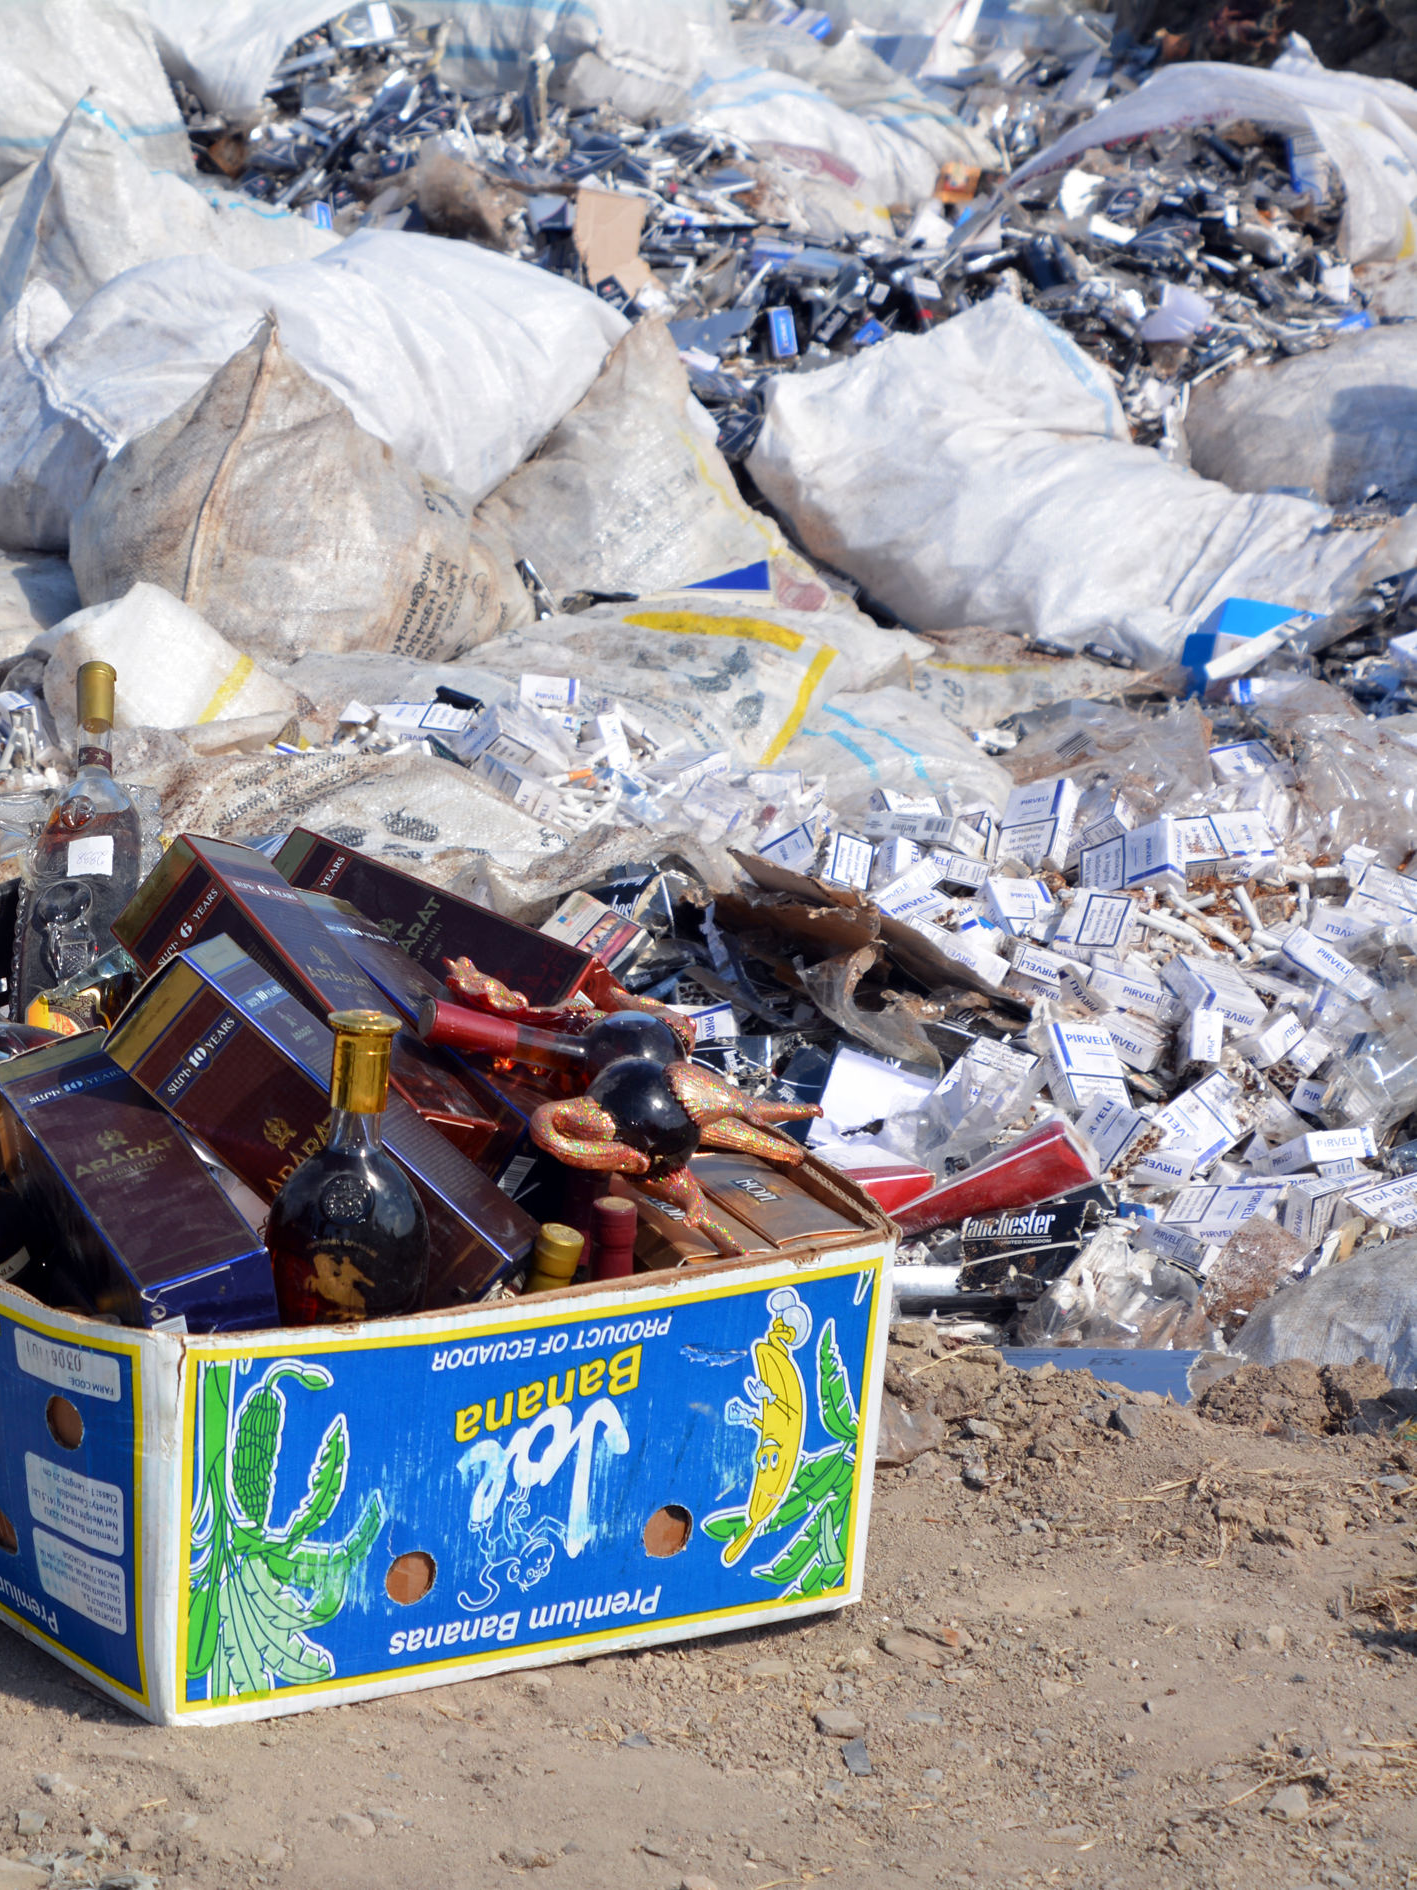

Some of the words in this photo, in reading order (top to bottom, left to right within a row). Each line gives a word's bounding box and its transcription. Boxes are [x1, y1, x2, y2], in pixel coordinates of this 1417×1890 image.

[534, 691, 563, 701] PIRVELI
[1020, 795, 1050, 806] PIRVELI
[1010, 824, 1046, 836] Smoking
[1017, 833, 1043, 843] highly
[933, 855, 950, 868] VELI
[1145, 837, 1153, 866] PIRVELI
[319, 855, 346, 888] YEARS
[1103, 859, 1112, 883] highly
[1112, 847, 1122, 881] Smoking
[257, 884, 270, 896] 6
[271, 889, 298, 901] YEARS
[890, 892, 937, 915] PIRVELI
[179, 920, 193, 939] 6
[192, 887, 219, 921] YEARS
[398, 896, 442, 954] ARAT
[1325, 923, 1354, 938] RVELI
[1020, 959, 1058, 980] PIRVELI
[1317, 947, 1351, 976] PIRVELI
[305, 963, 373, 991] ARARAT
[255, 990, 269, 1002] 10
[267, 984, 284, 997] YEARS
[1069, 980, 1099, 1013] PIRVELI
[1122, 985, 1161, 1005] PIRVELI
[703, 1014, 716, 1038] PIRV
[188, 1046, 208, 1068] 10
[205, 1017, 236, 1050] YEARS
[1065, 1033, 1111, 1046] PIRVELI
[1109, 1031, 1143, 1055] IRVELI
[1297, 1051, 1311, 1067] VELI
[62, 1079, 84, 1093] 10
[85, 1068, 125, 1085] YEARS
[1161, 1111, 1190, 1138] VELI
[1316, 1136, 1358, 1148] PIRVELI
[74, 1135, 175, 1179] ARARAT
[1272, 1151, 1293, 1168] PIRVELI
[1240, 1190, 1265, 1220] PIRVELI
[1363, 1189, 1393, 1206] you
[963, 1209, 1057, 1238] anchester
[1153, 1228, 1182, 1245] PIRVELI
[540, 1331, 570, 1356] OF
[571, 1315, 673, 1352] PRODUCT
[431, 1337, 538, 1372] ECUADOR
[68, 1376, 91, 1390] CODE:
[92, 1386, 114, 1396] FARM
[453, 1342, 644, 1444] Banana
[455, 1397, 630, 1559] Joe
[56, 1486, 89, 1509] Cavendish
[96, 1489, 118, 1504] Class:
[79, 1510, 103, 1526] Weight
[89, 1501, 118, 1518] Variety:
[61, 1516, 86, 1534] Bananas
[104, 1520, 118, 1532] Net
[86, 1527, 119, 1546] Premium
[90, 1564, 120, 1581] MACHALA
[93, 1609, 122, 1627] EXPORTED
[528, 1585, 663, 1630] Premium
[388, 1610, 522, 1656] Bananas
